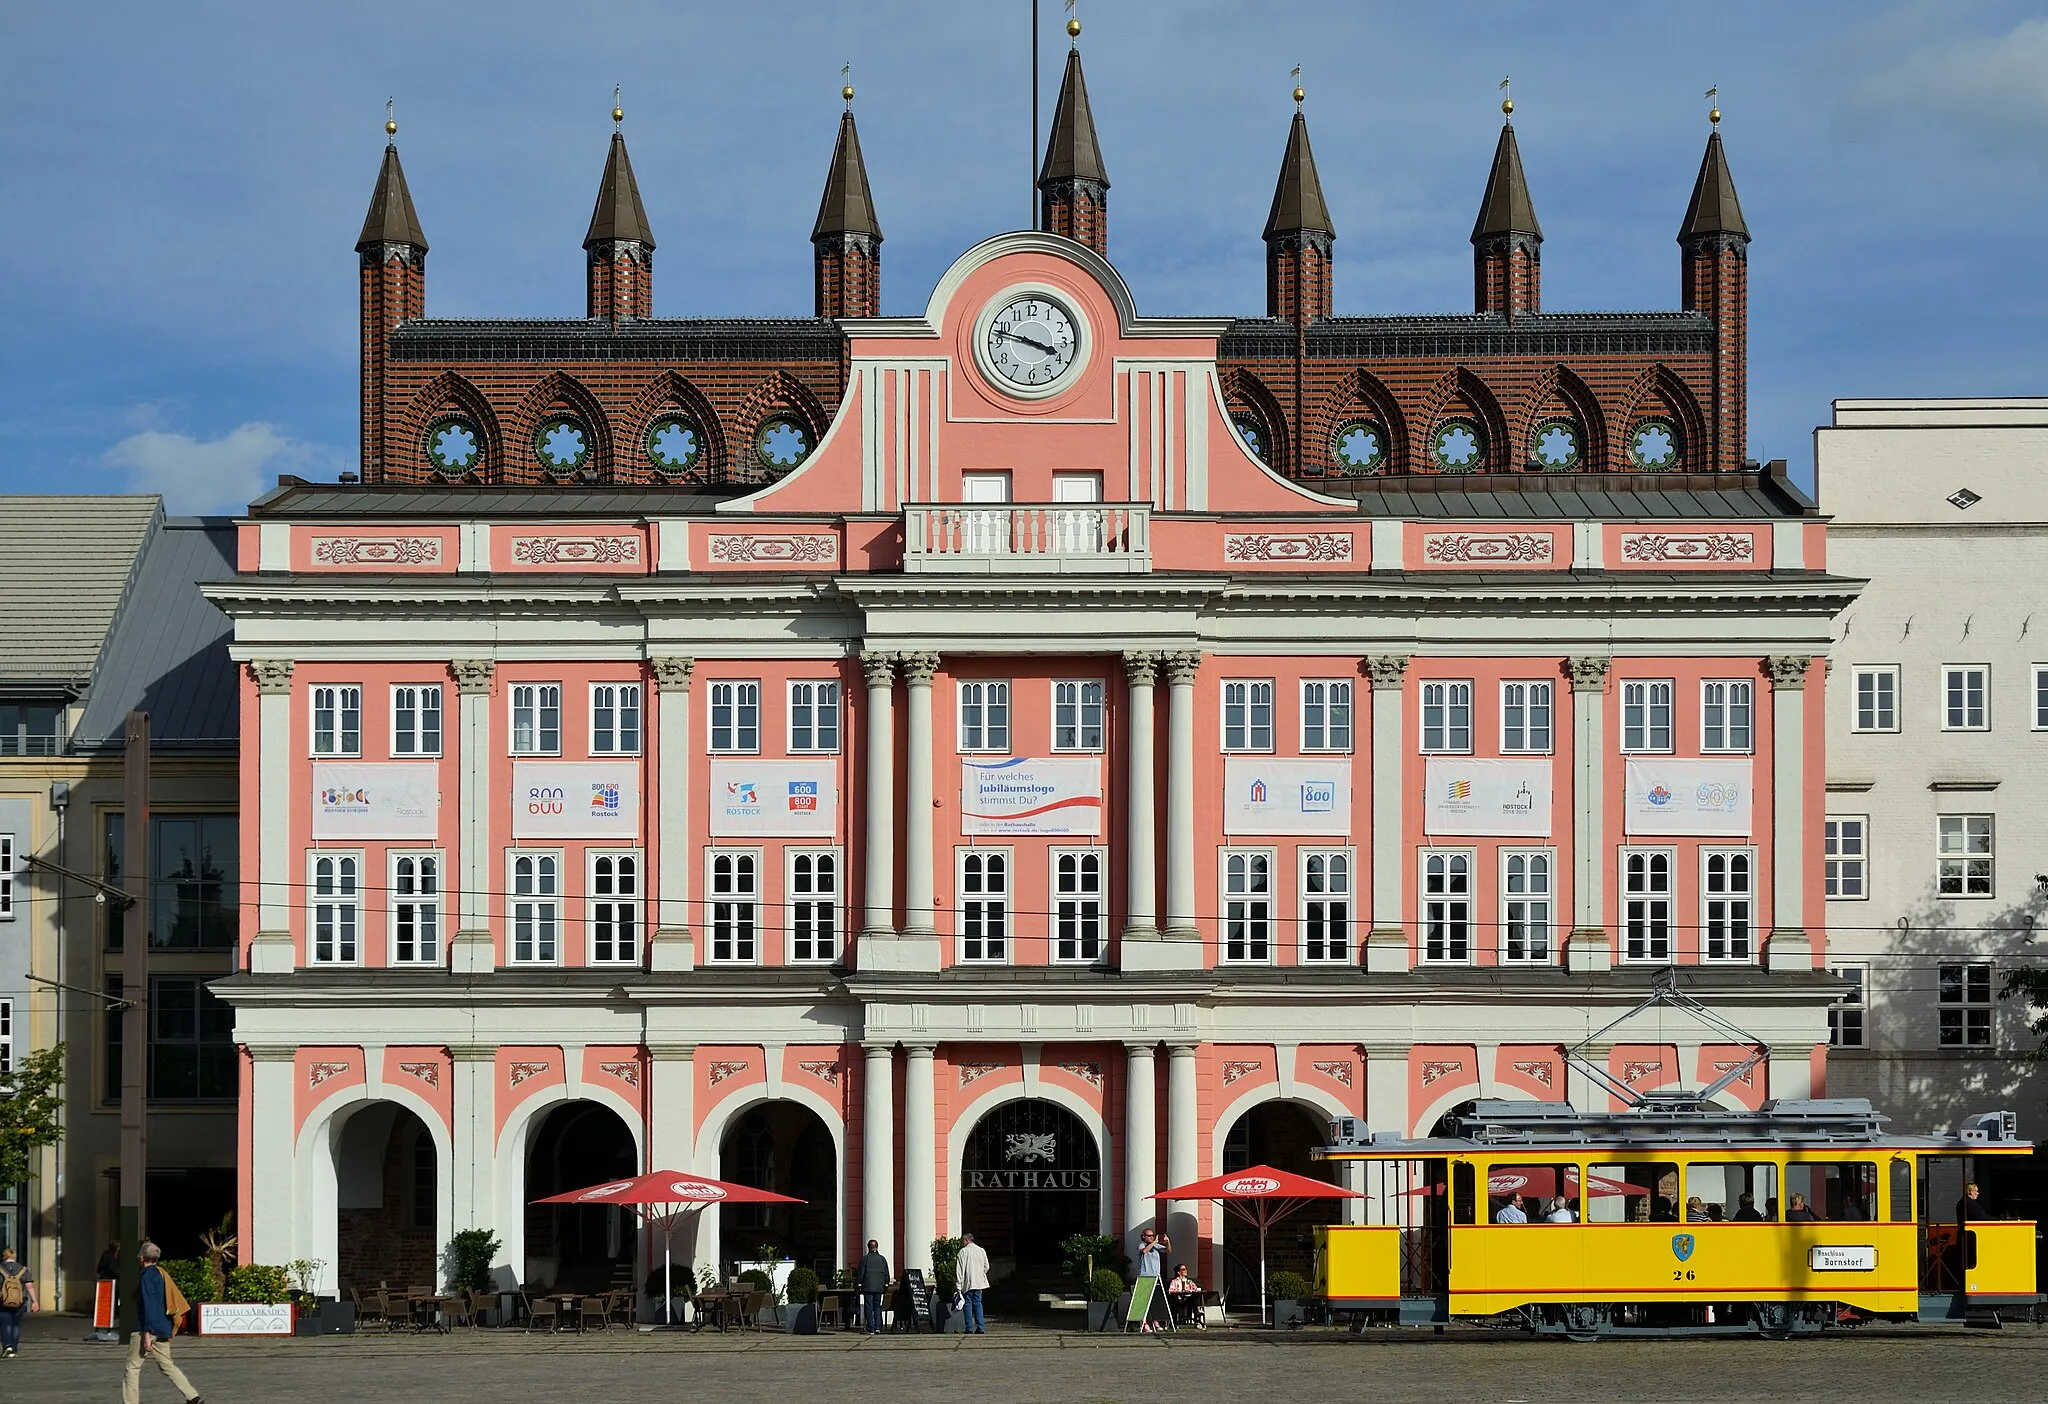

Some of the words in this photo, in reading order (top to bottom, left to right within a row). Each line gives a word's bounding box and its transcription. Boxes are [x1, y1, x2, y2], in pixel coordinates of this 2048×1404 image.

[1012, 310, 1022, 321] 11
[1026, 304, 1038, 316] 12
[1045, 309, 1050, 320] 1
[1000, 321, 1010, 332] 10
[1056, 322, 1064, 333] 2
[996, 336, 1004, 348] 9
[1060, 336, 1068, 348] 3
[1000, 352, 1008, 364] 8
[1055, 353, 1062, 364] 4
[1012, 364, 1019, 377] 7
[1028, 368, 1036, 380] 6
[1044, 364, 1052, 376] 5
[980, 772, 995, 781] Für
[997, 772, 1034, 781] welches
[794, 786, 812, 794] 600
[980, 784, 1055, 794] Jubiläumslogo
[1305, 786, 1330, 801] 800
[980, 796, 1016, 804] stimmst
[1019, 796, 1037, 804] Du?
[970, 1172, 1091, 1188] RATHAUS
